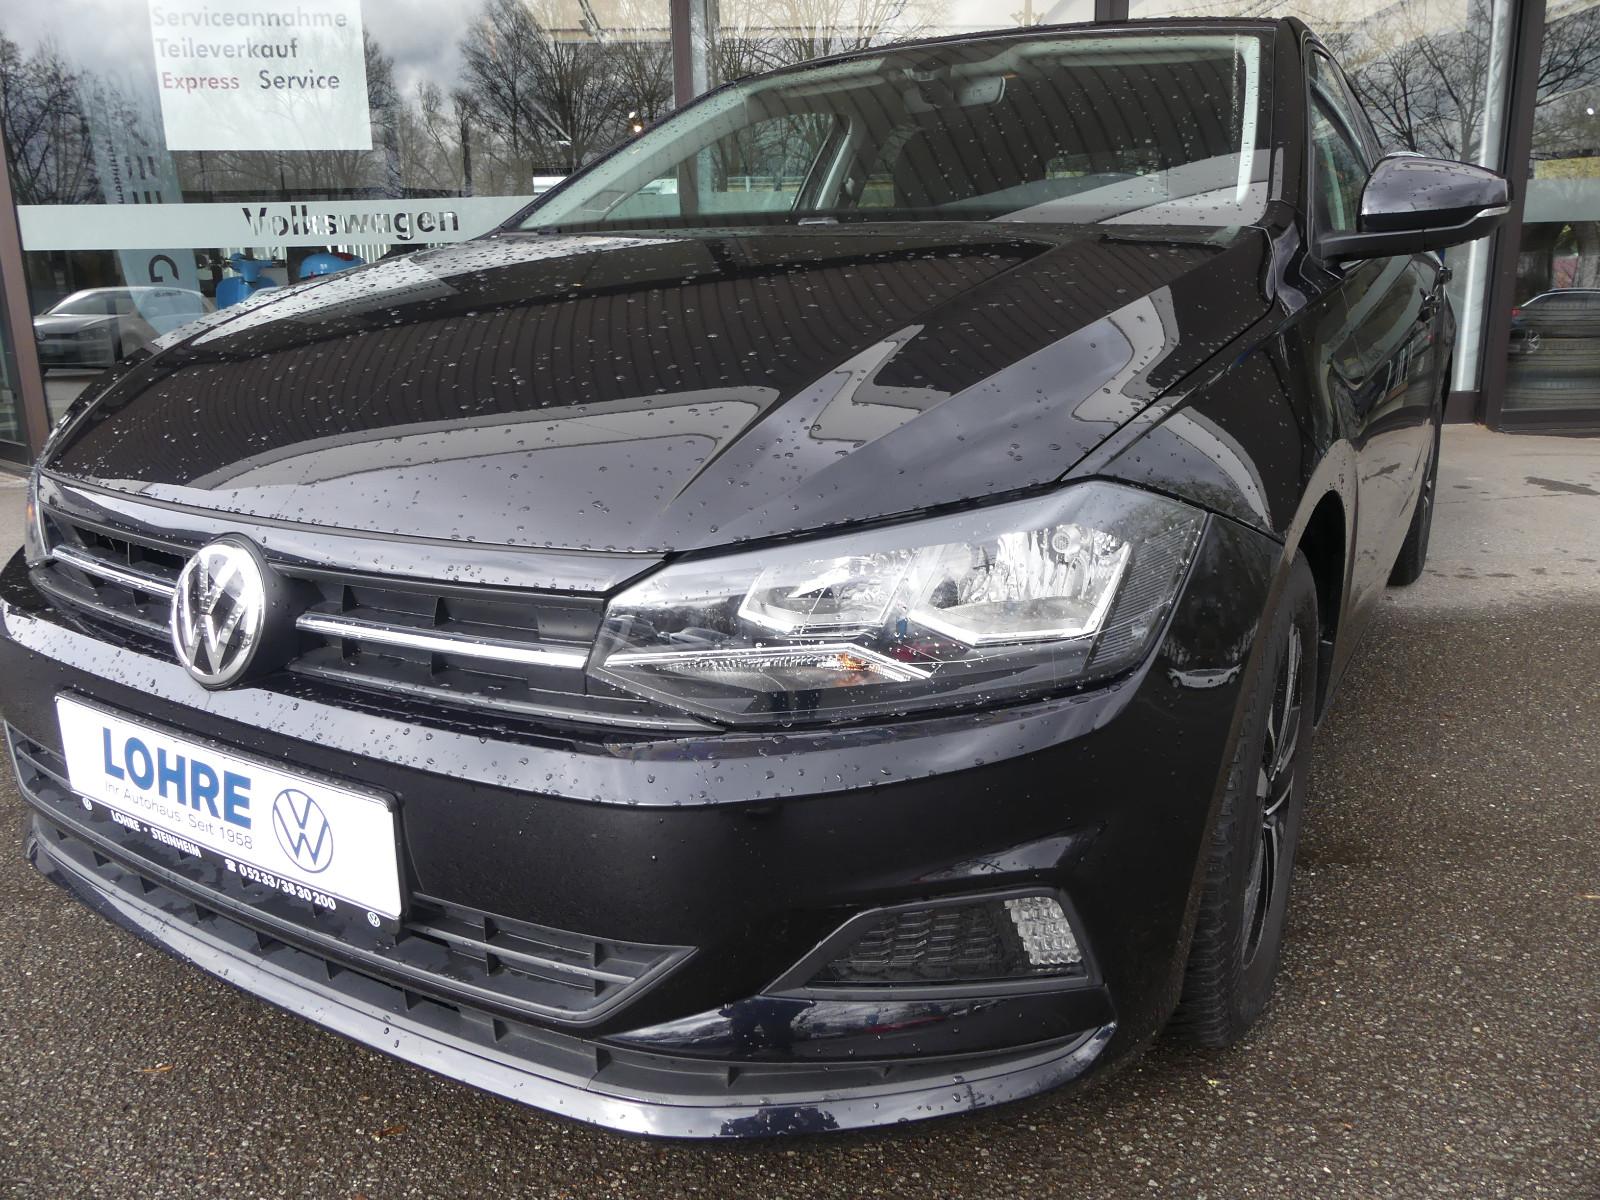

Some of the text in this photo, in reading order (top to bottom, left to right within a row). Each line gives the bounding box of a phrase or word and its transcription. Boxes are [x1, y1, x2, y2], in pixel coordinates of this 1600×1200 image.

[152, 6, 348, 28] Serviceannahme
[155, 38, 298, 58] Teileverkauf
[162, 69, 340, 93] Express Service
[242, 205, 459, 240] Volkswagen
[102, 727, 252, 829] LOHRE
[105, 782, 254, 850] Ihr Autohaus Seit 1958
[110, 809, 202, 858] LOHRE STEINHEIM
